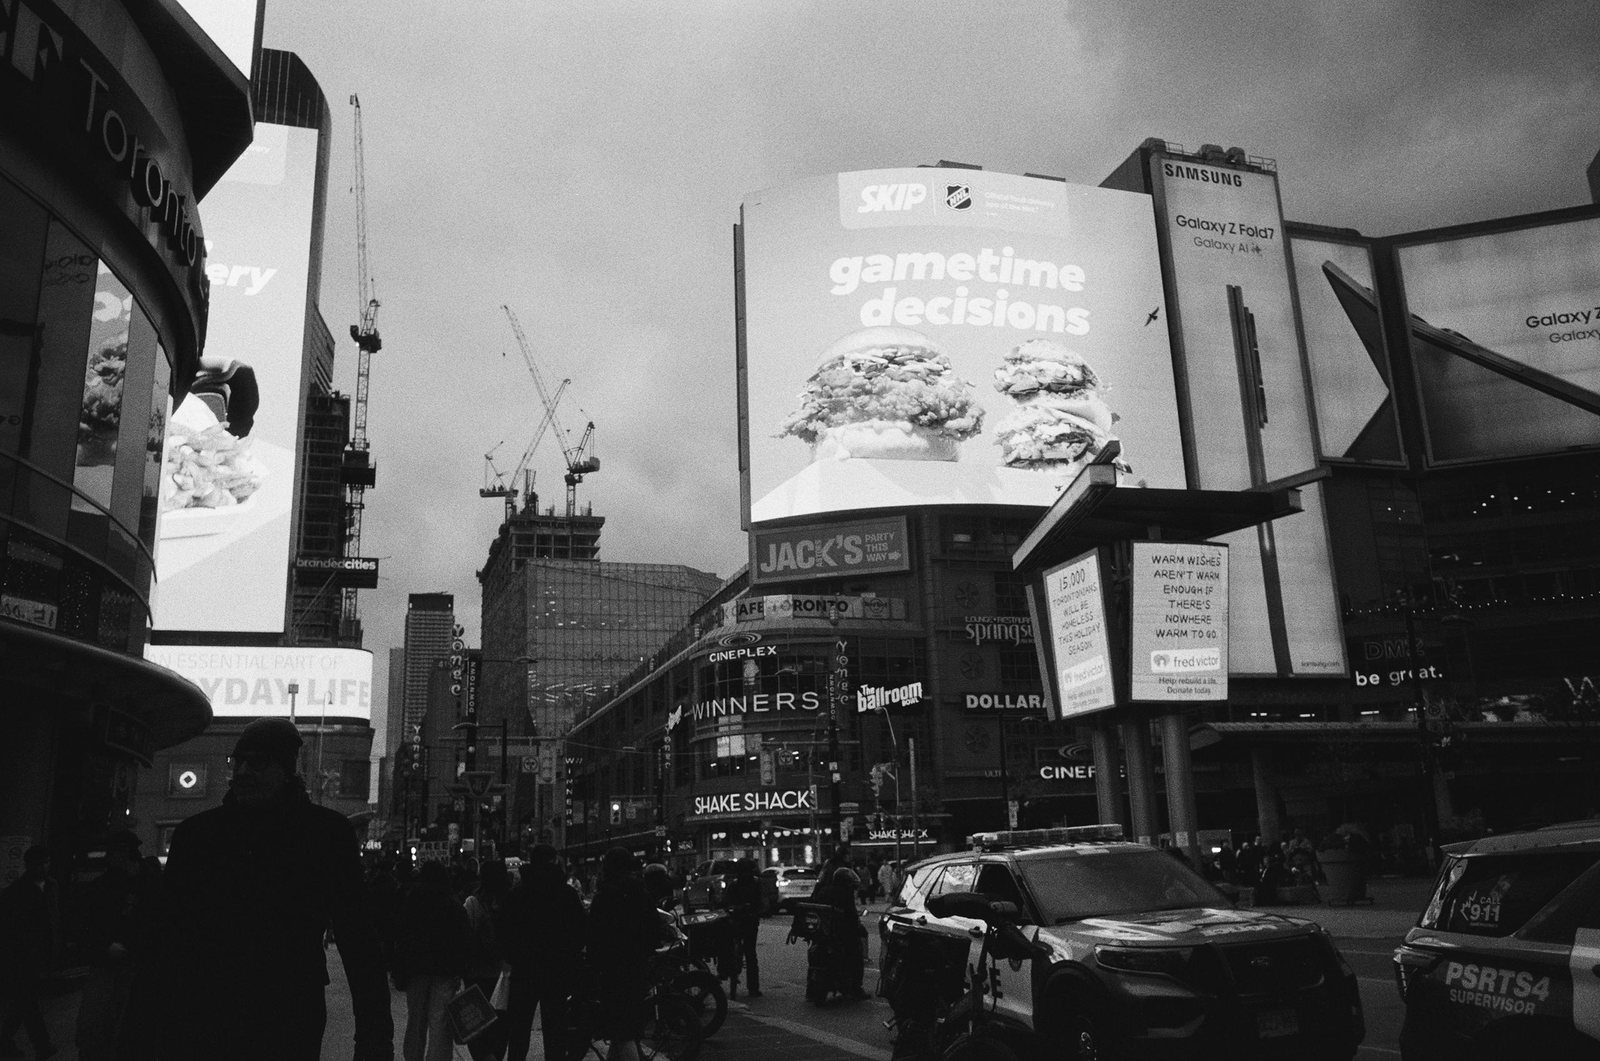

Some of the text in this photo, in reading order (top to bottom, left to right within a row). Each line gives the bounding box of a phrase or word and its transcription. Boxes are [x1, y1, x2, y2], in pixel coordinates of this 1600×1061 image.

[80, 58, 198, 267] Toronto
[1164, 163, 1242, 188] SAMSUNG
[857, 183, 927, 213] SKIP
[1176, 214, 1275, 240] Galaxy Z Fold7
[1193, 236, 1236, 254] Galaxy
[829, 246, 1086, 295] gametime
[860, 286, 1091, 336] decisions
[1525, 310, 1591, 328] Galaxy
[865, 532, 895, 543] PARTY
[760, 534, 863, 573] JACK'S
[866, 543, 889, 553] THIS
[866, 553, 888, 562] WAY
[1151, 555, 1221, 567] WARM WISHES
[1059, 568, 1086, 591] 15,000
[1153, 570, 1220, 580] AREN'T WARM
[1163, 585, 1214, 595] ENOUGH IF
[1064, 600, 1090, 617] WILL BE
[1168, 600, 1211, 610] THERE'S
[1062, 611, 1094, 630] HOMELESS
[1165, 614, 1212, 625] NOWHERE
[1058, 622, 1101, 645] THIS HOLIDAY
[1156, 629, 1188, 639] WARM
[1192, 629, 1204, 639] TO
[709, 645, 777, 663] CINEPLEX
[1068, 640, 1093, 656] SEASON
[177, 653, 270, 670] ESSENTIAL
[274, 655, 313, 670] PART
[320, 656, 344, 671] OF
[1174, 655, 1219, 668] fred victor
[1159, 677, 1177, 685] Help
[1355, 670, 1380, 686] be
[307, 678, 369, 707] LIFE
[857, 682, 923, 713] ballroom
[860, 684, 876, 695] The
[692, 691, 820, 721] WINNERS
[695, 790, 810, 815] SHAKE SHACK
[1445, 962, 1550, 1002] PSRTS4
[1450, 988, 1536, 1015] SUPERVISOR
